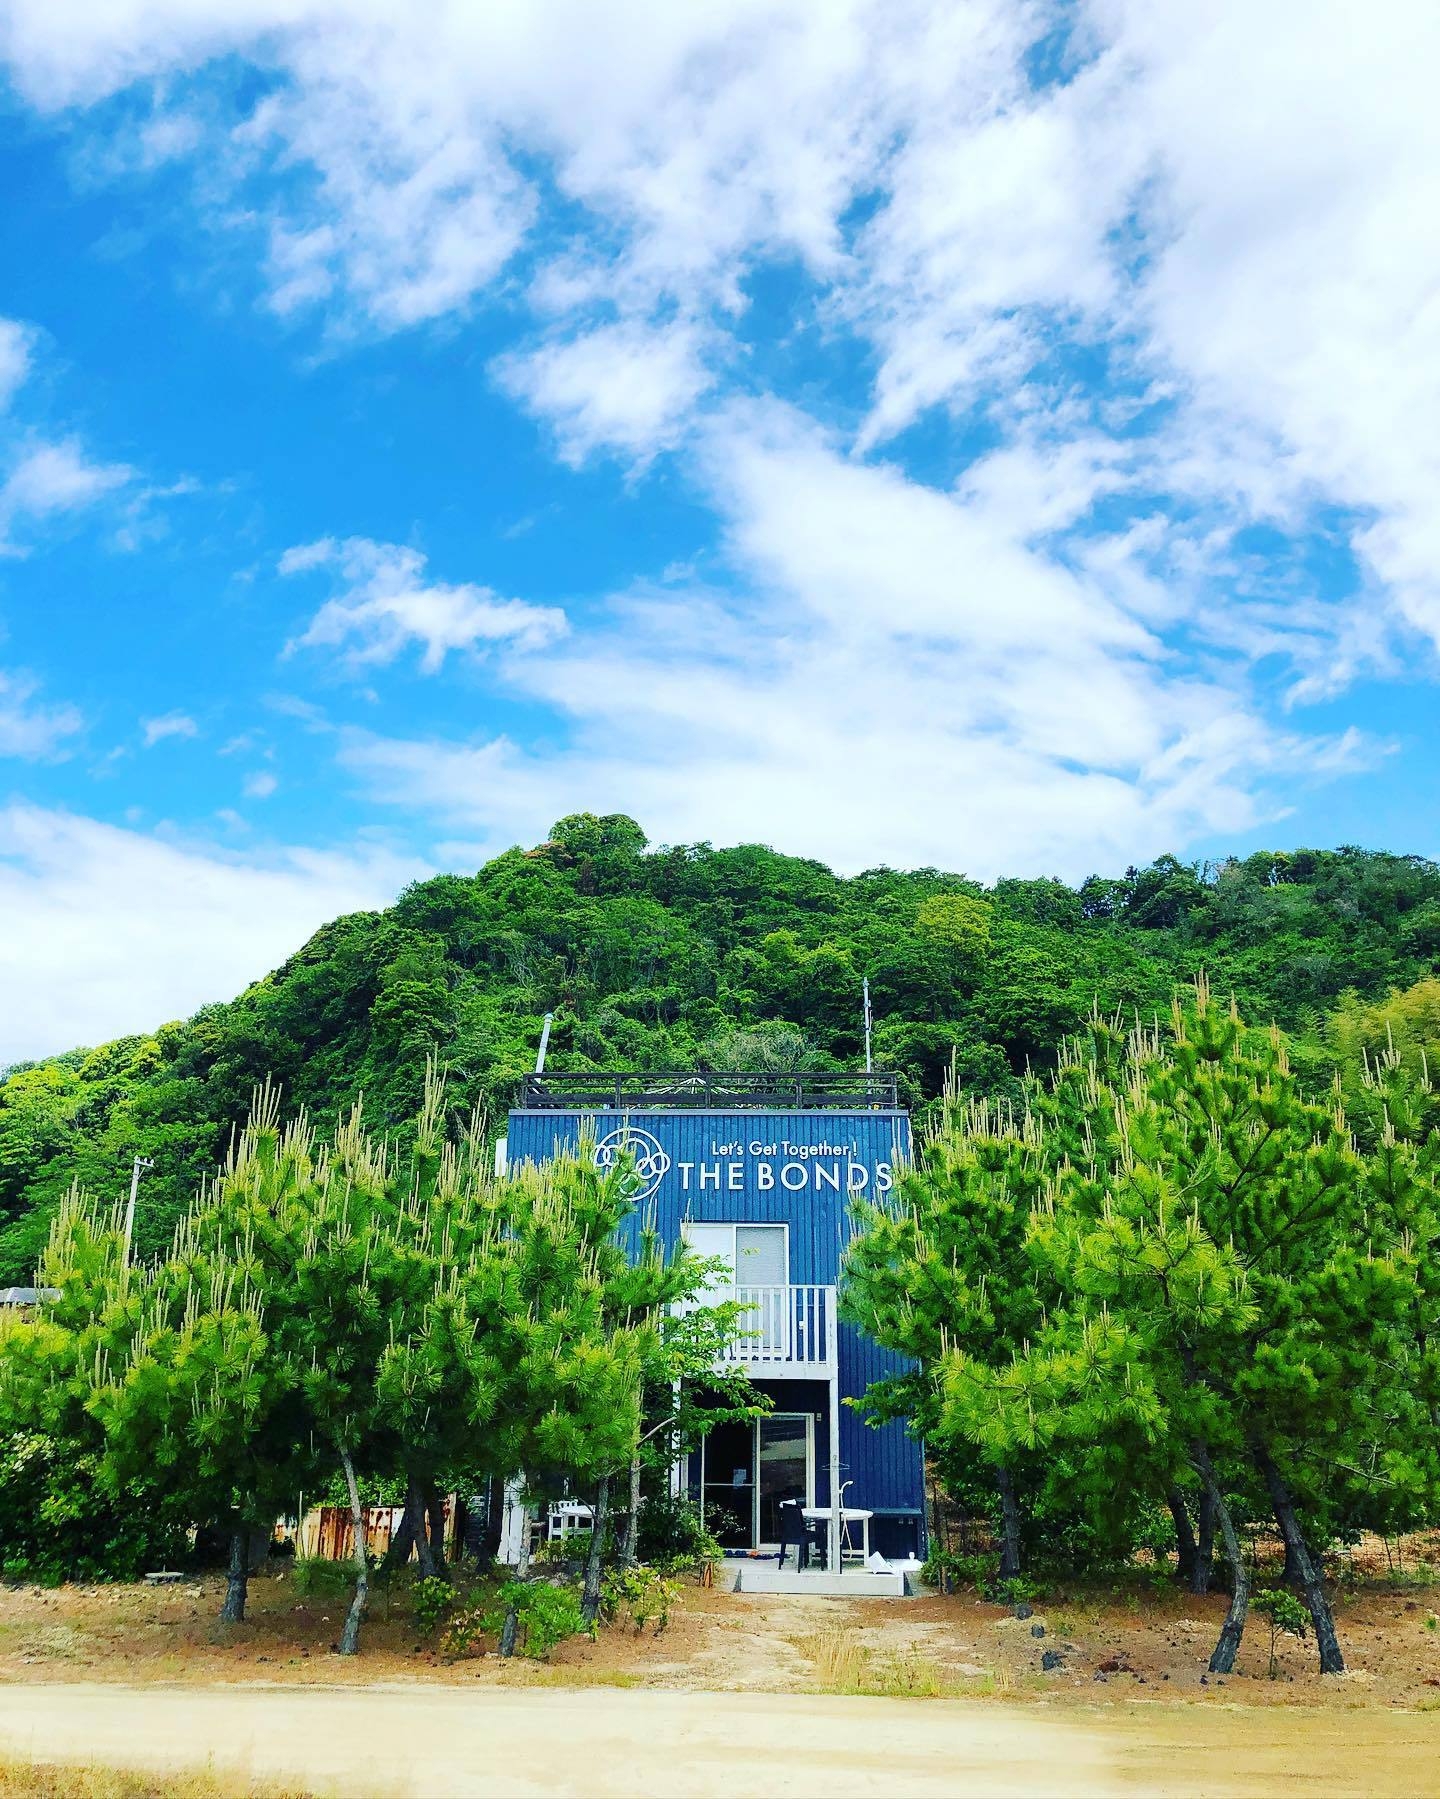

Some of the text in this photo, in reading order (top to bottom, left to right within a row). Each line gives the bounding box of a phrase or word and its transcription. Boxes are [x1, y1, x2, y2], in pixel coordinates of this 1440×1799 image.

[712, 1140, 744, 1156] Let's
[749, 1140, 777, 1156] Get
[677, 1162, 893, 1191] THE BONDS
